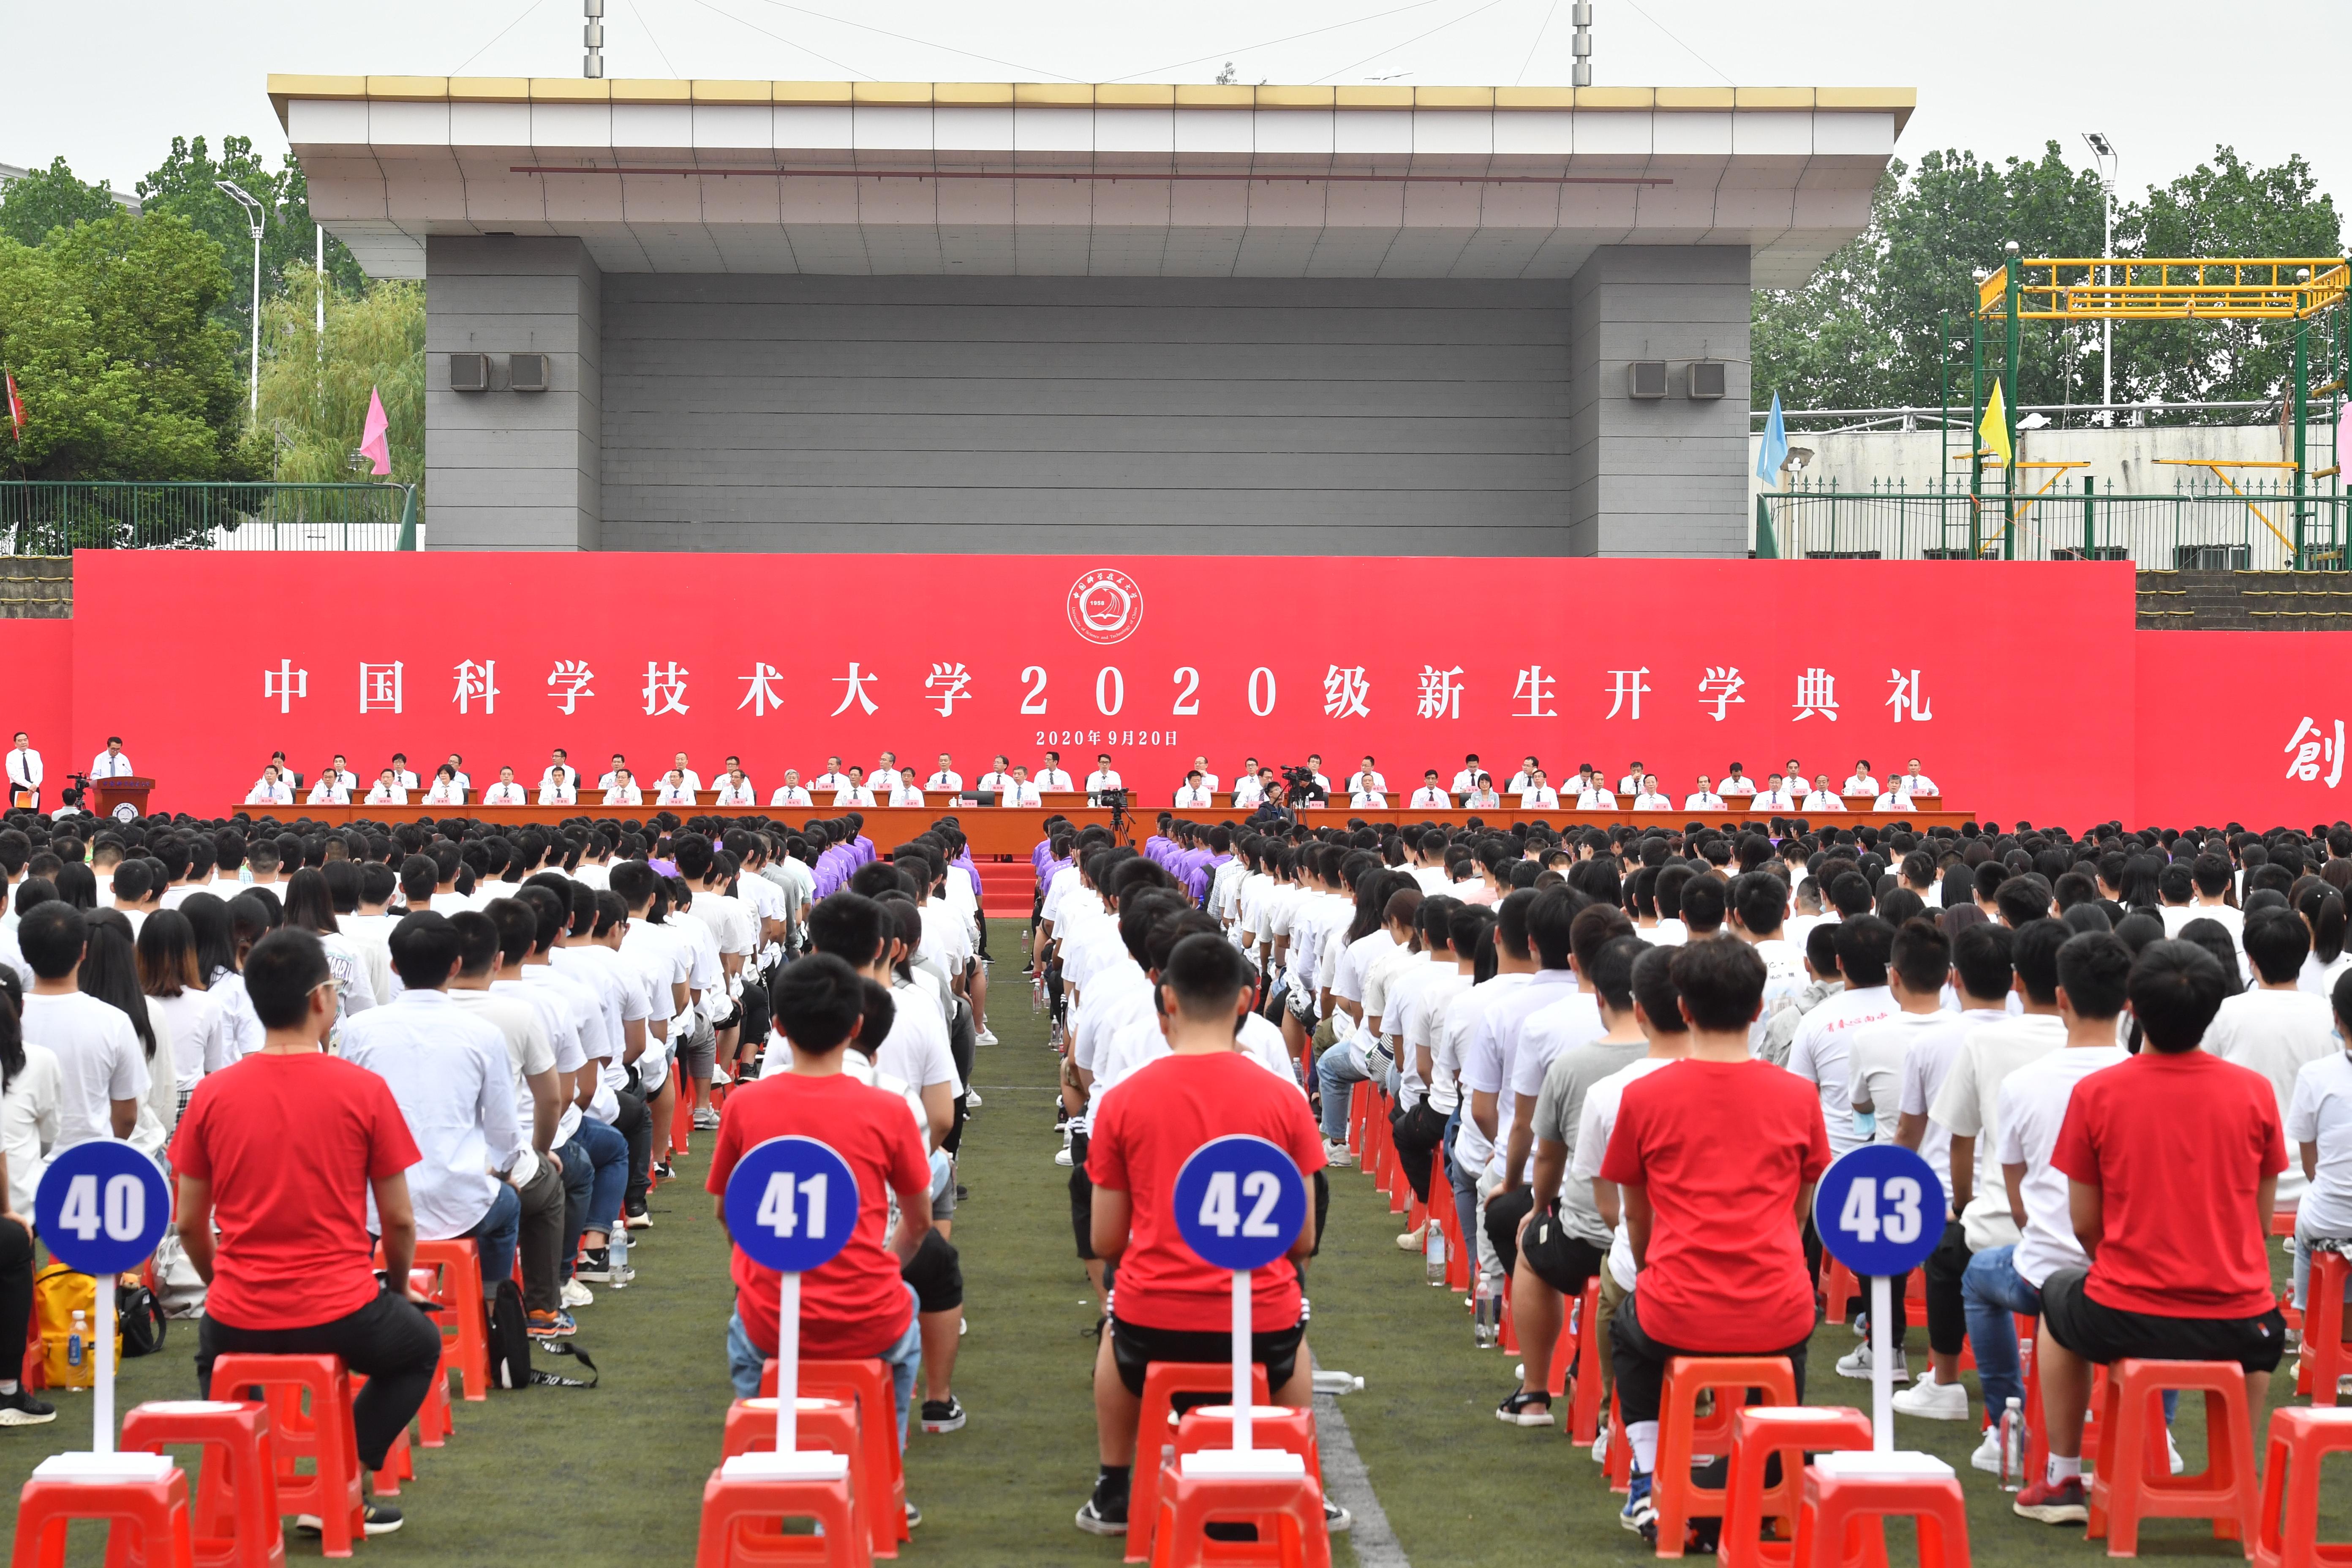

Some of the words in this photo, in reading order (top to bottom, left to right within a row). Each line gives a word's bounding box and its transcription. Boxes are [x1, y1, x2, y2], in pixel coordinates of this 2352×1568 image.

[1071, 607, 1081, 627] University
[1085, 630, 1100, 639] Science
[1110, 625, 1131, 639] Technology
[265, 659, 1932, 723] 中国科学技术大学2020级新生开学典礼
[1036, 730, 1176, 746] 2020年9月20日
[59, 1174, 144, 1241] 40
[757, 1172, 827, 1239] 41
[1199, 1171, 1280, 1237] 42
[1840, 1177, 1922, 1243] 43
